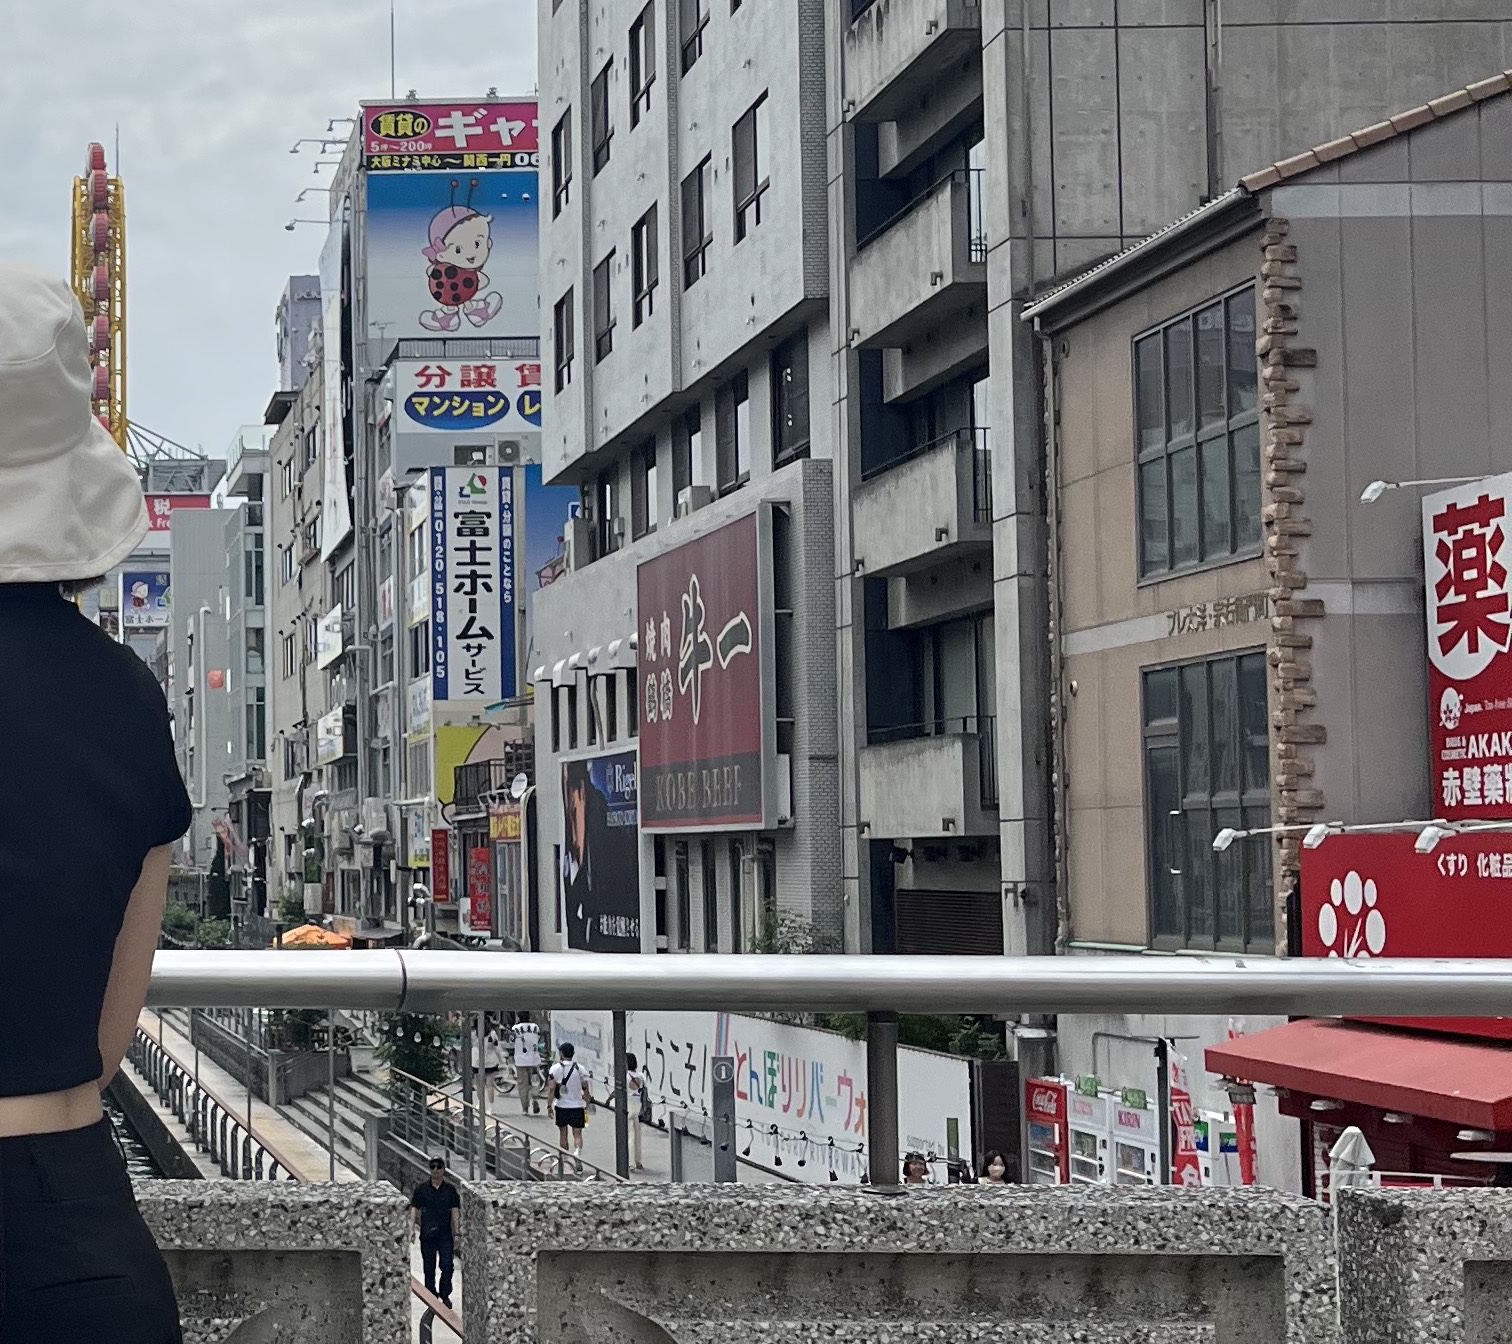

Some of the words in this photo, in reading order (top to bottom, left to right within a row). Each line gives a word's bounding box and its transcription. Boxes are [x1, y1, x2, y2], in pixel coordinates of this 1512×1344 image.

[378, 112, 429, 138] 賃貸の
[434, 107, 539, 149] ギャ
[411, 395, 505, 417] マンション
[1432, 494, 1511, 657] 薬
[453, 509, 495, 695] 富士ホームサービス
[678, 574, 753, 725] 牛一
[656, 771, 697, 812] KOBE
[702, 764, 742, 809] BEEF
[1437, 853, 1468, 877] くすり
